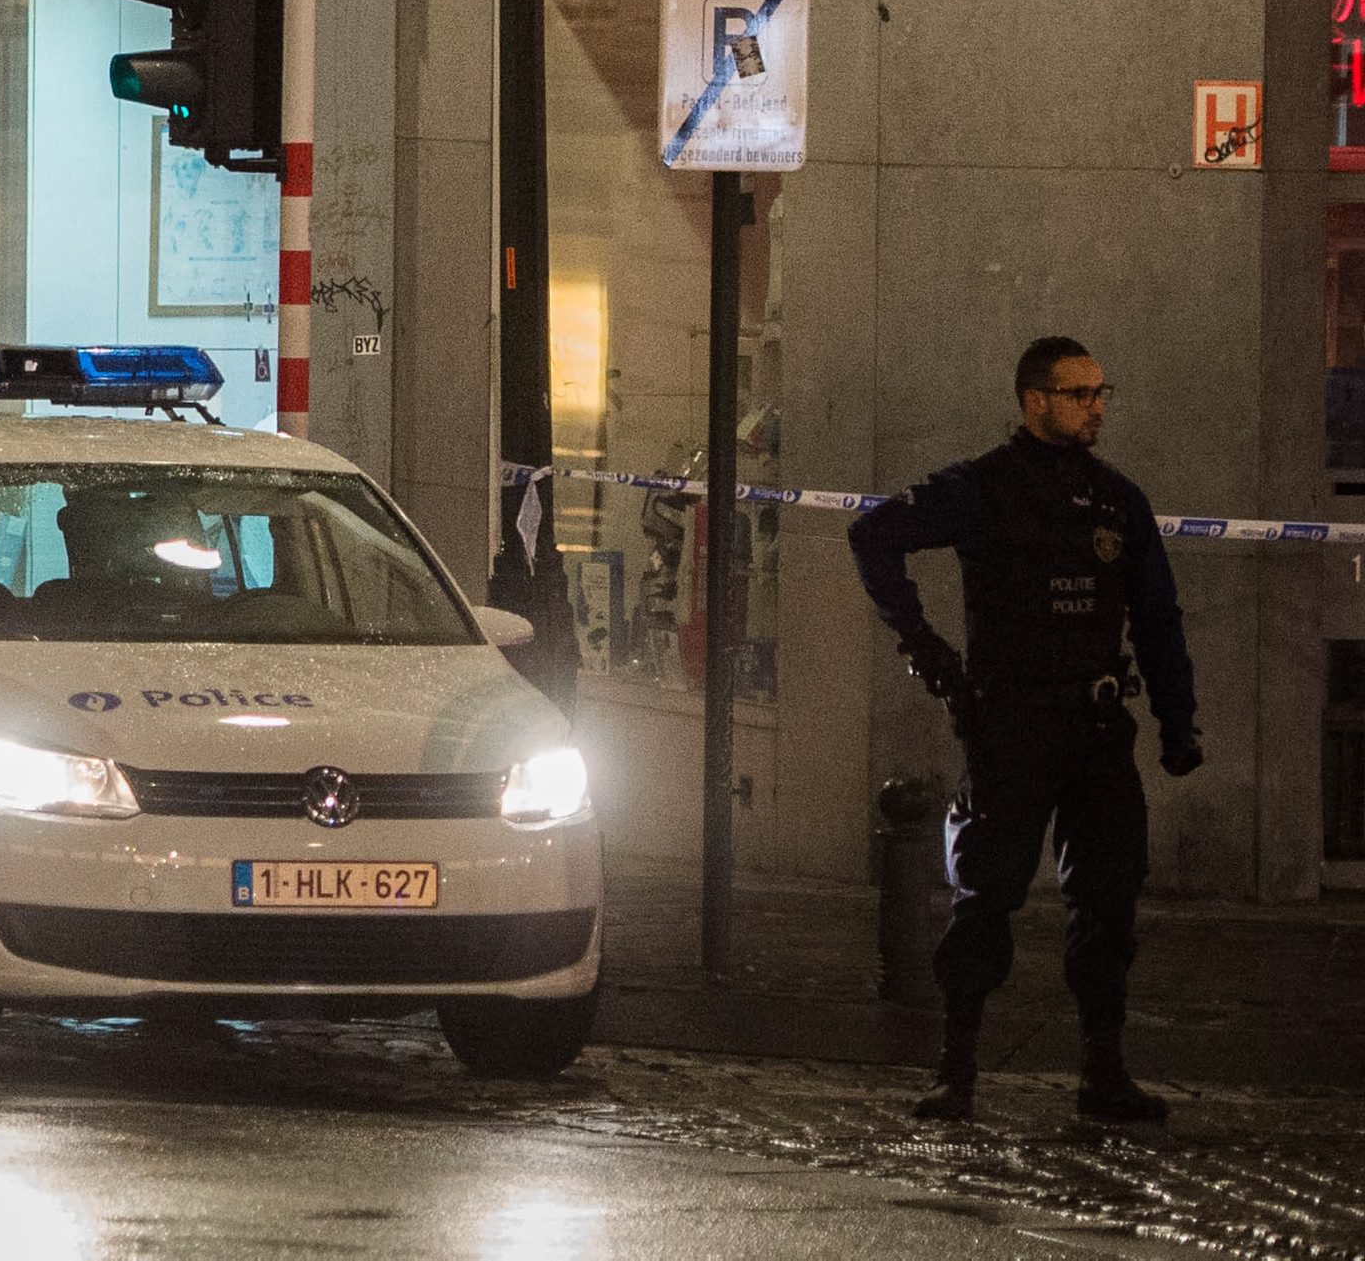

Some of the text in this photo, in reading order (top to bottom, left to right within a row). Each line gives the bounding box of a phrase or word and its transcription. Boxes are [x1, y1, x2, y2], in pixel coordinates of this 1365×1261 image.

[1206, 94, 1246, 157] H
[746, 149, 804, 164] bewoners
[355, 337, 379, 354] BYZ
[1053, 599, 1095, 613] POLICE
[142, 689, 314, 708] Police
